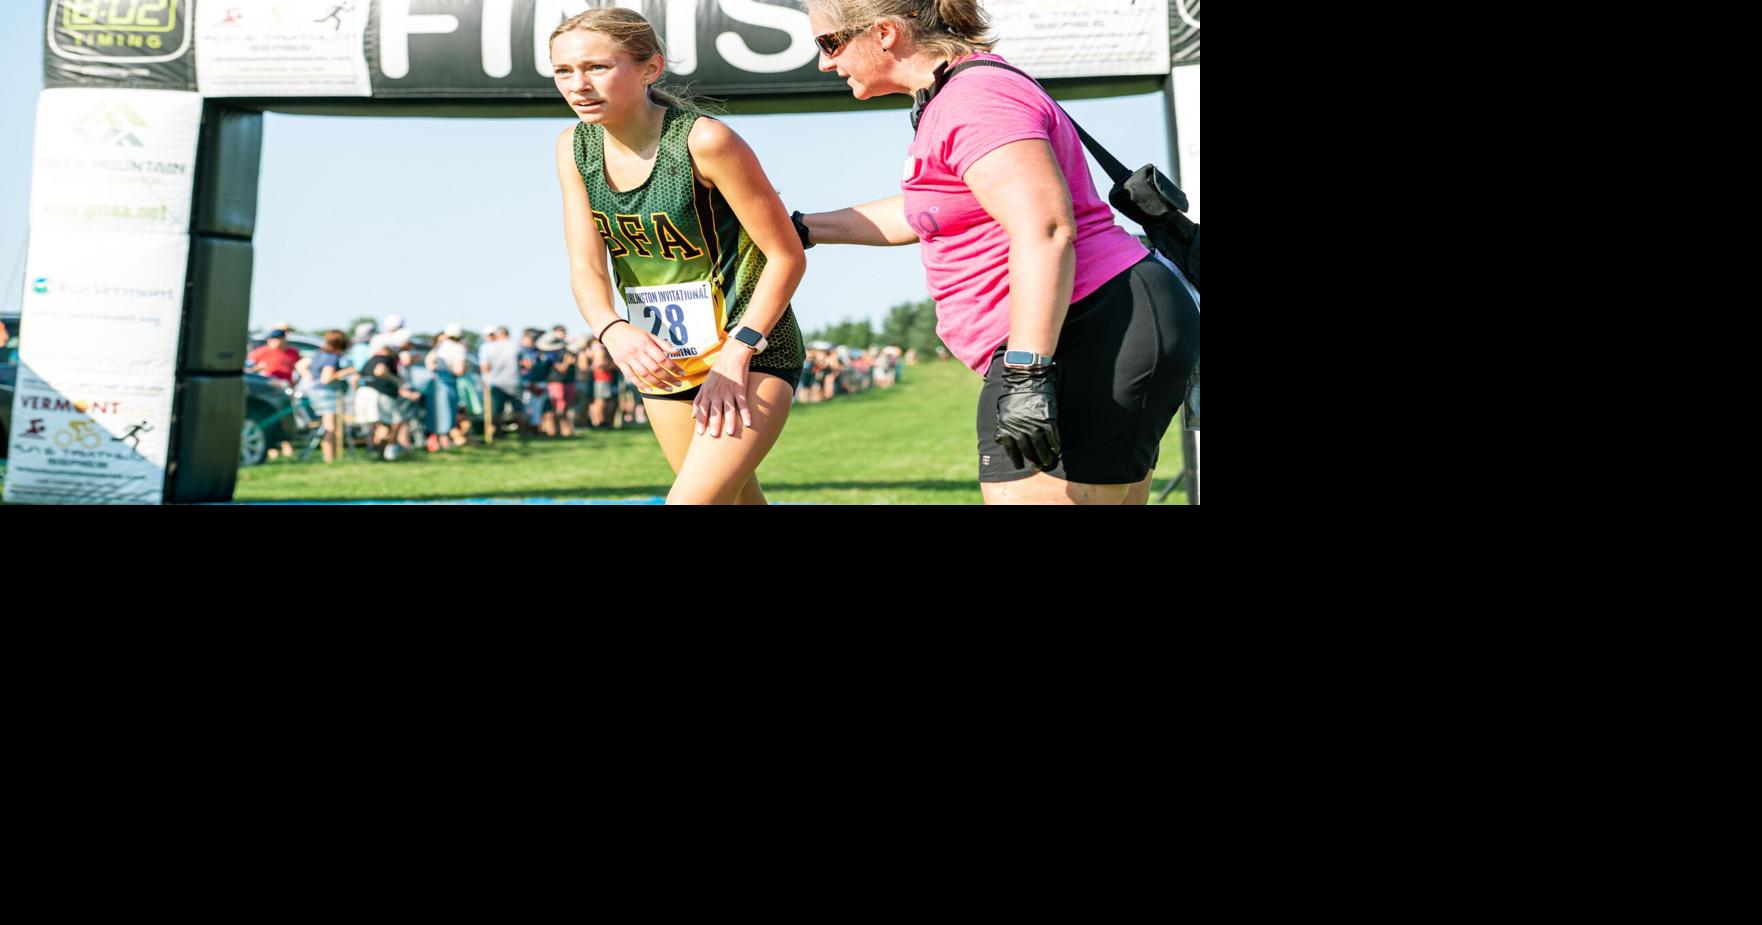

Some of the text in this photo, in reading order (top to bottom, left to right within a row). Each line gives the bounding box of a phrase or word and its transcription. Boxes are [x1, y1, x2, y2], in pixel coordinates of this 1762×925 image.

[74, 33, 162, 49] TIMING
[91, 159, 186, 174] MOUNTAIN
[592, 210, 704, 261] BFA
[658, 287, 709, 302] INVITATIONAL
[643, 304, 688, 345] 28
[20, 395, 120, 414] VERMONT
